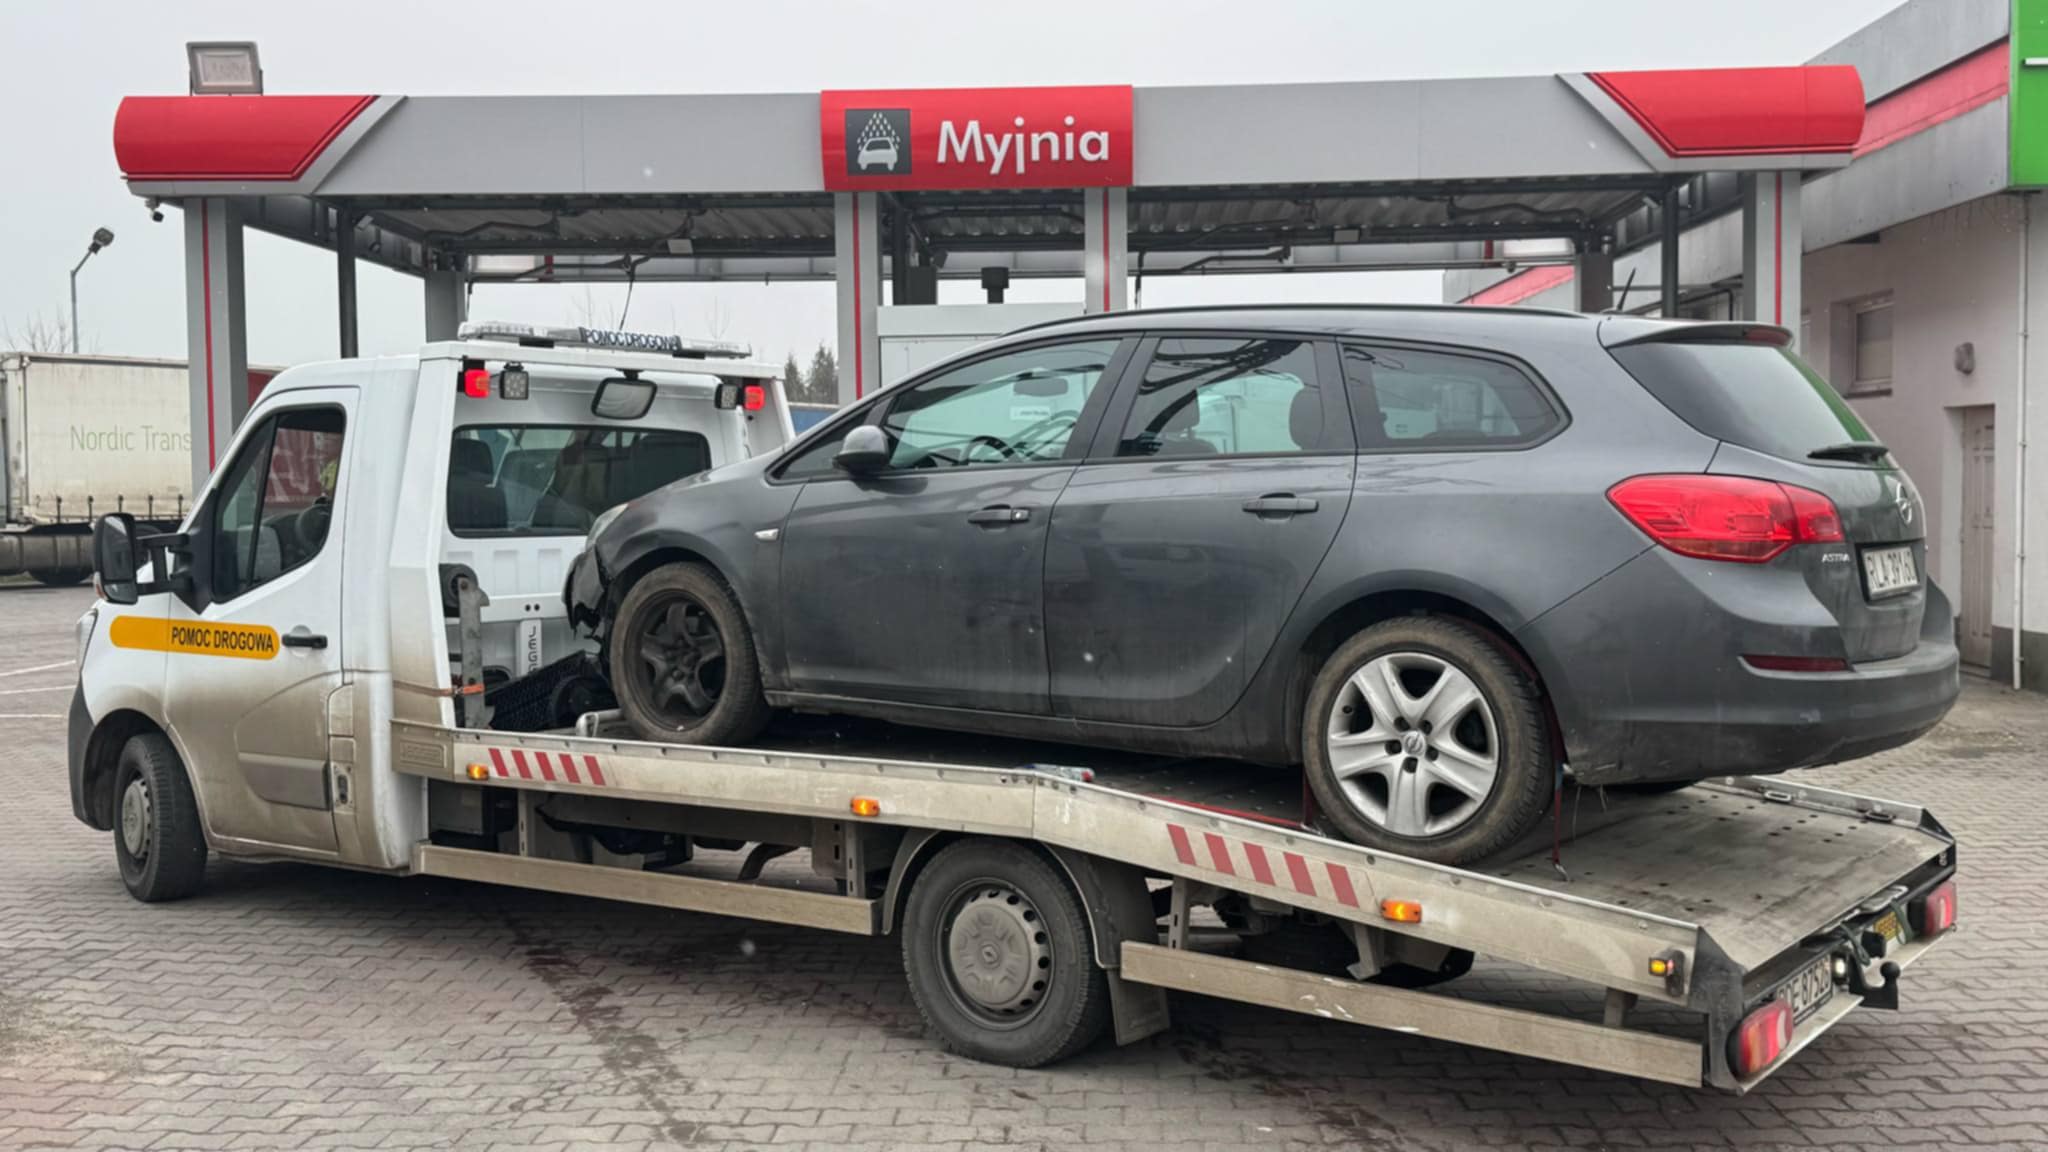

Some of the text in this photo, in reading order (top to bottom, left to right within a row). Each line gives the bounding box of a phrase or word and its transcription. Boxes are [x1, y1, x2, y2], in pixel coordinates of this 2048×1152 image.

[937, 115, 1109, 175] Myjnia
[584, 328, 680, 352] POMOC DROGOWA
[70, 424, 192, 452] Nordic Trans
[1822, 553, 1850, 563] ASTRA
[171, 626, 275, 652] POMOC DROGOWA
